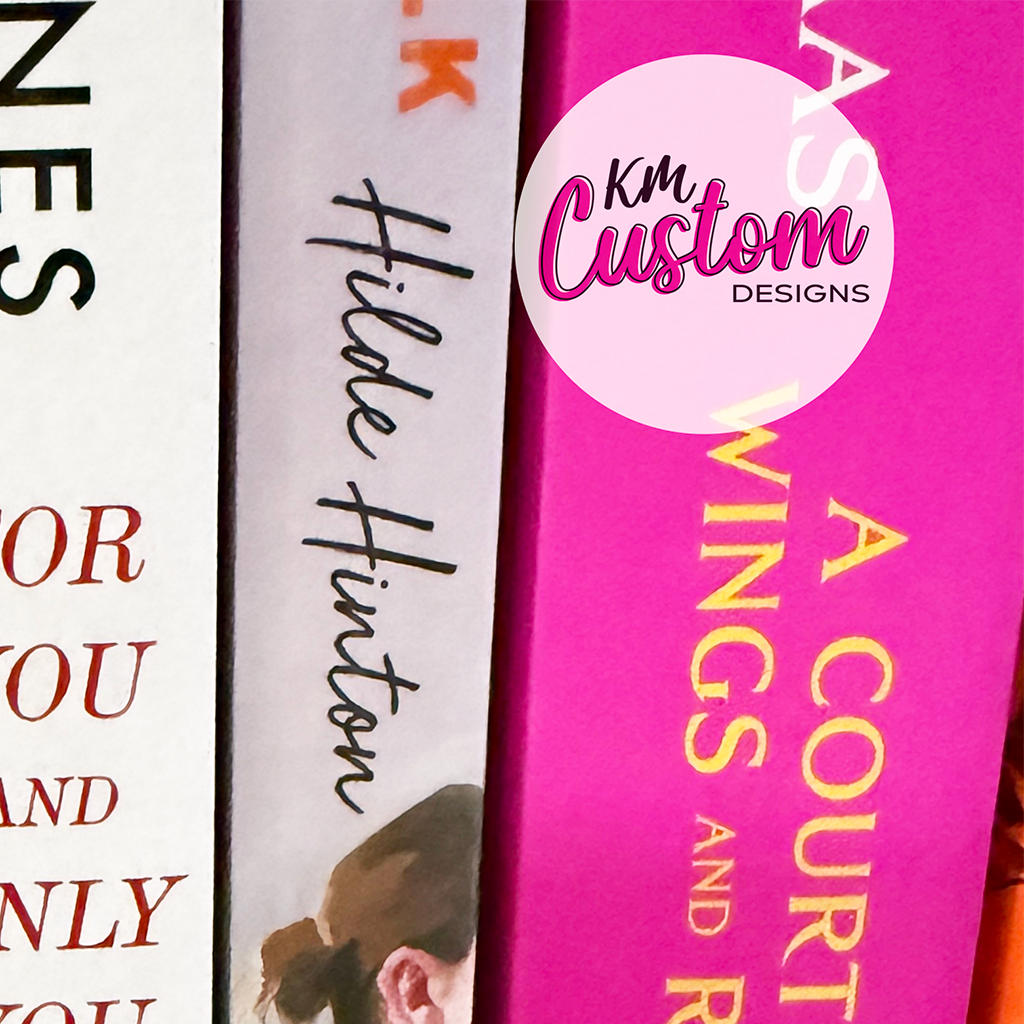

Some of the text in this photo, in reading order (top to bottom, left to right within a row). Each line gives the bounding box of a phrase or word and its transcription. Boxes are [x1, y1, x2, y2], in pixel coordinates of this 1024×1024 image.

[399, 0, 478, 113] K
[786, 0, 890, 208] AS
[302, 178, 474, 814] Hilde Hinton
[682, 380, 799, 774] WINGS
[820, 497, 908, 584] A
[687, 814, 736, 936] AND
[779, 635, 893, 1022] COURT
